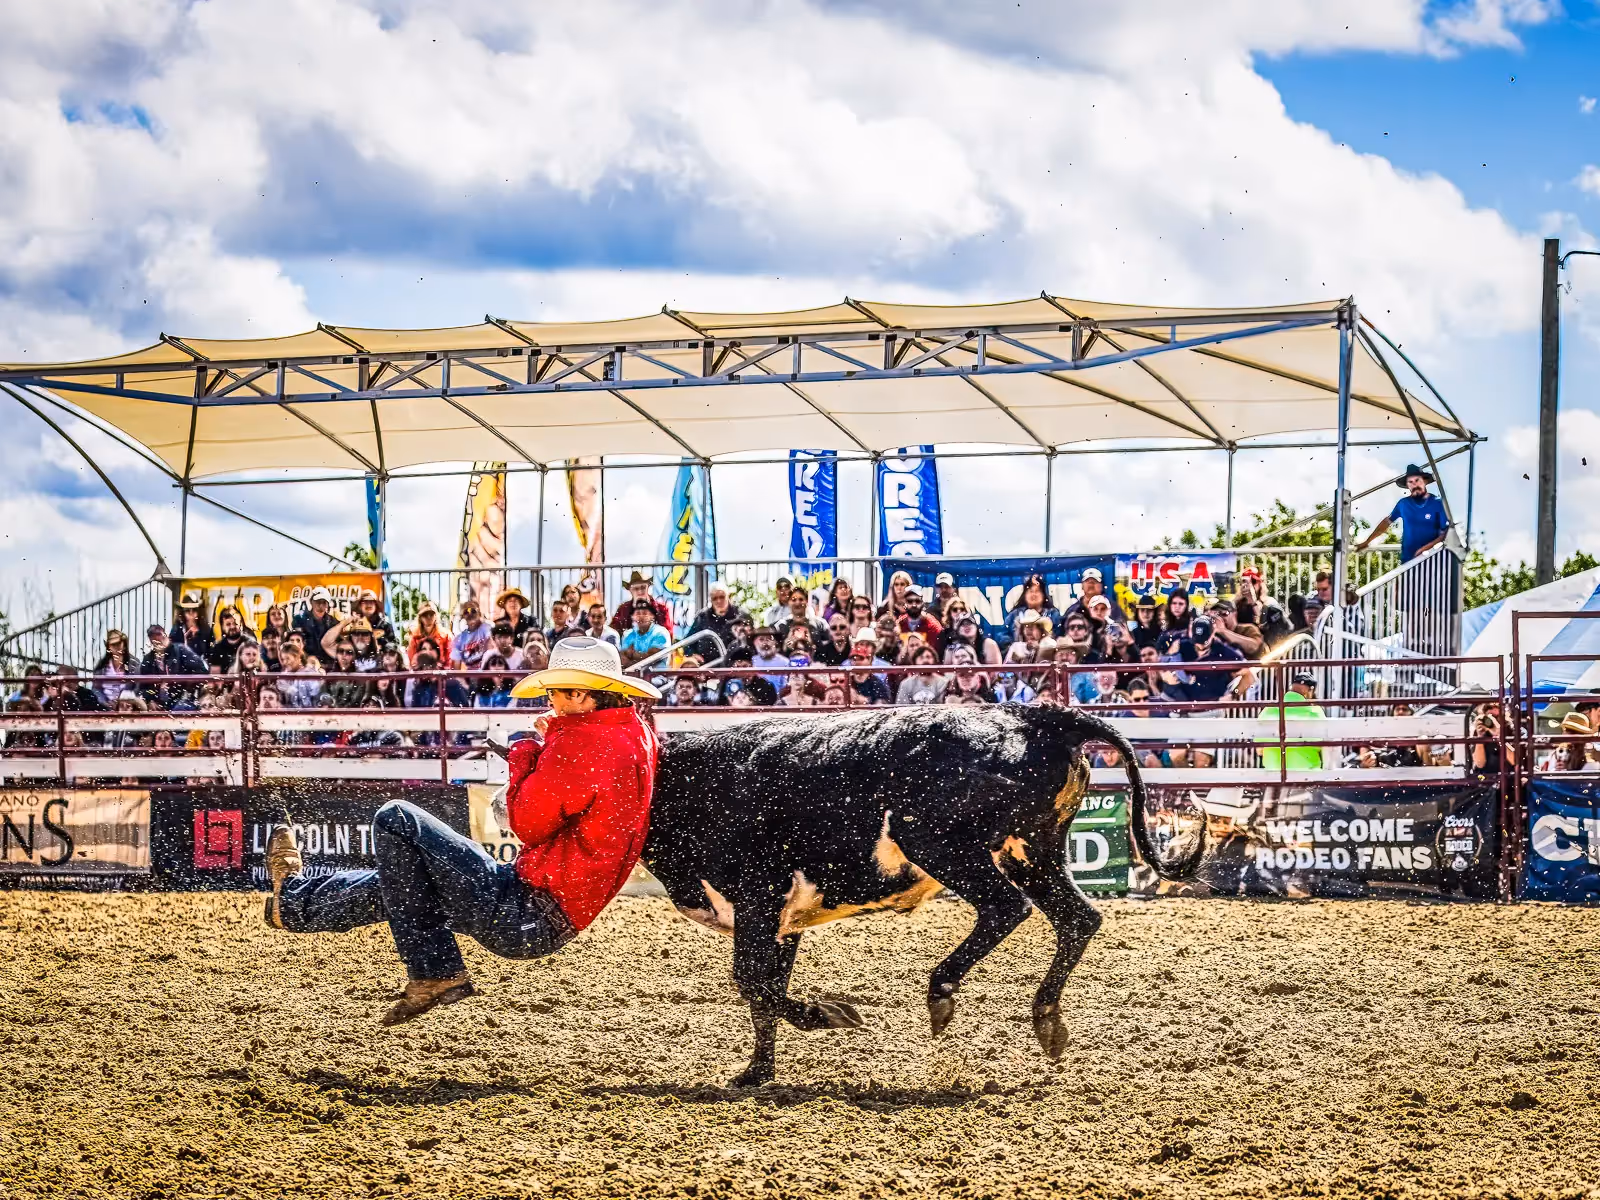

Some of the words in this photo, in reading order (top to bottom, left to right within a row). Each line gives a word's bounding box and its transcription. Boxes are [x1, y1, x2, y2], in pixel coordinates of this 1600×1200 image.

[1130, 561, 1218, 597] USA
[0, 798, 74, 866] NS
[1265, 818, 1415, 843] WELCOME
[1444, 814, 1475, 828] Coors
[252, 823, 351, 855] LICOLN
[1254, 847, 1351, 870] RODEO
[1356, 846, 1433, 870] FANS
